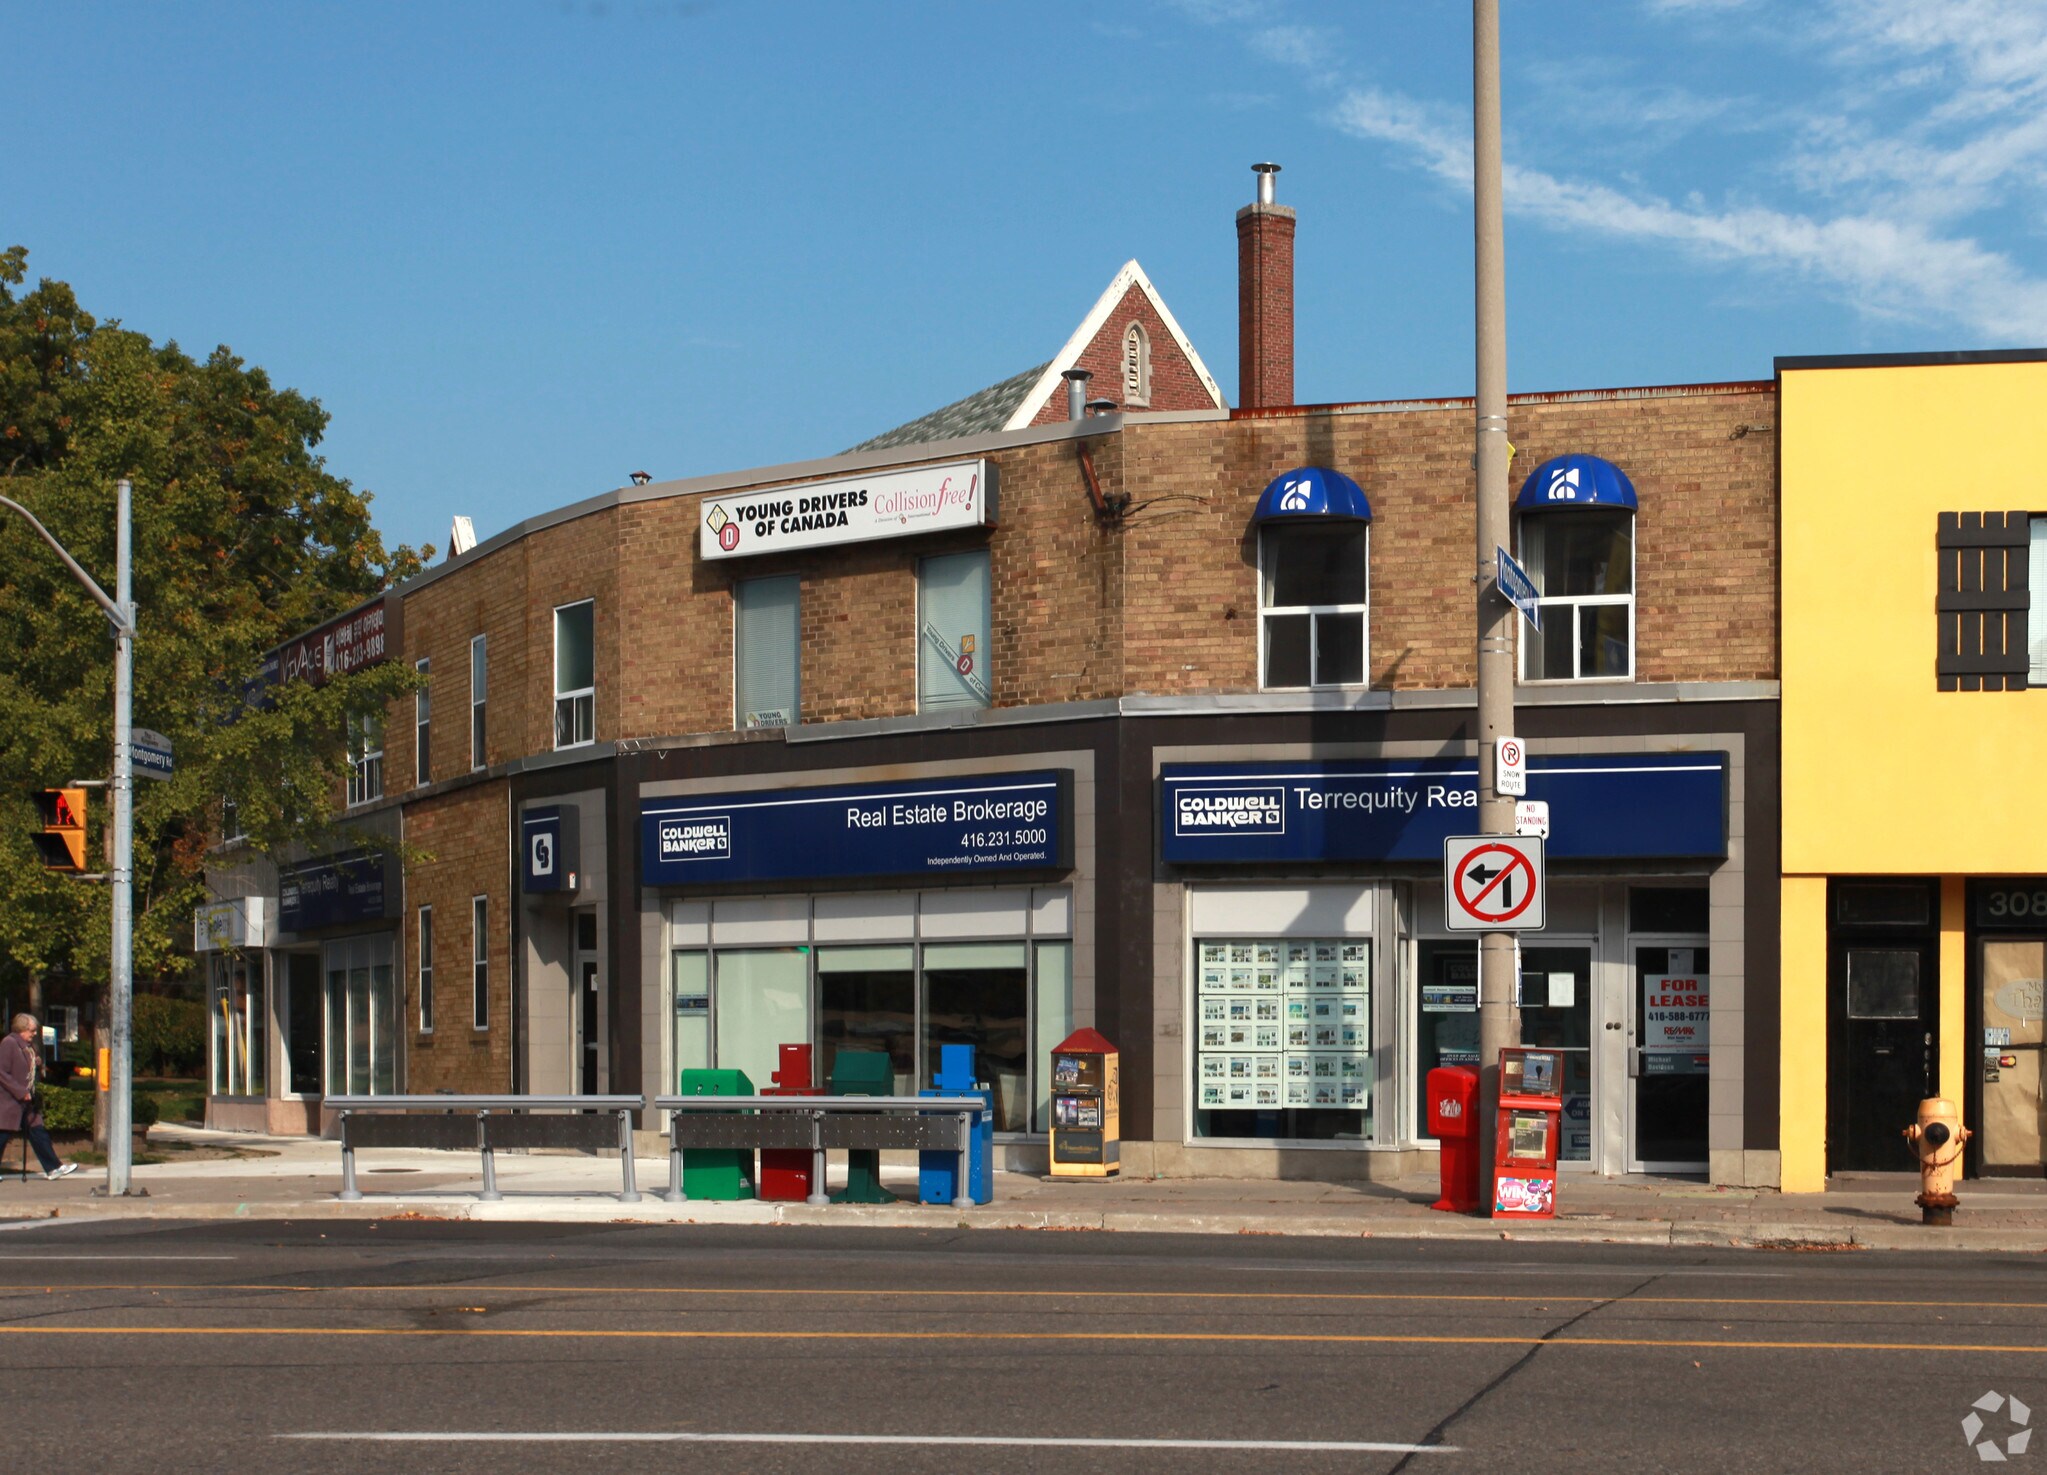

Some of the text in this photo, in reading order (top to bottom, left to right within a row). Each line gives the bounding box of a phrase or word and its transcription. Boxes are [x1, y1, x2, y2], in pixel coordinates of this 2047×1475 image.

[735, 489, 868, 522] YOUNG DRIVERS
[755, 510, 849, 537] OF CANADA
[758, 711, 782, 720] YOUNG
[760, 718, 788, 727] DRIVERS
[166, 756, 173, 767] Rd
[1503, 770, 1520, 778] SNOW
[1501, 780, 1521, 790] ROUTE
[1179, 796, 1280, 811] COLDWELL
[1294, 786, 1477, 813] Terrequity Rea
[847, 799, 1048, 829] Real Estate Brokerage
[1526, 804, 1535, 813] NO
[1181, 811, 1262, 827] BANKER
[1515, 816, 1547, 825] STANDING
[662, 824, 728, 840] COLDWELL
[961, 829, 1047, 848] 416.231.5000
[662, 838, 716, 854] BANKER
[927, 851, 1047, 867] Independently Owned And Operated.
[1989, 892, 2047, 916] 308
[1661, 979, 1697, 991] FOR
[1650, 995, 1709, 1007] LEASE
